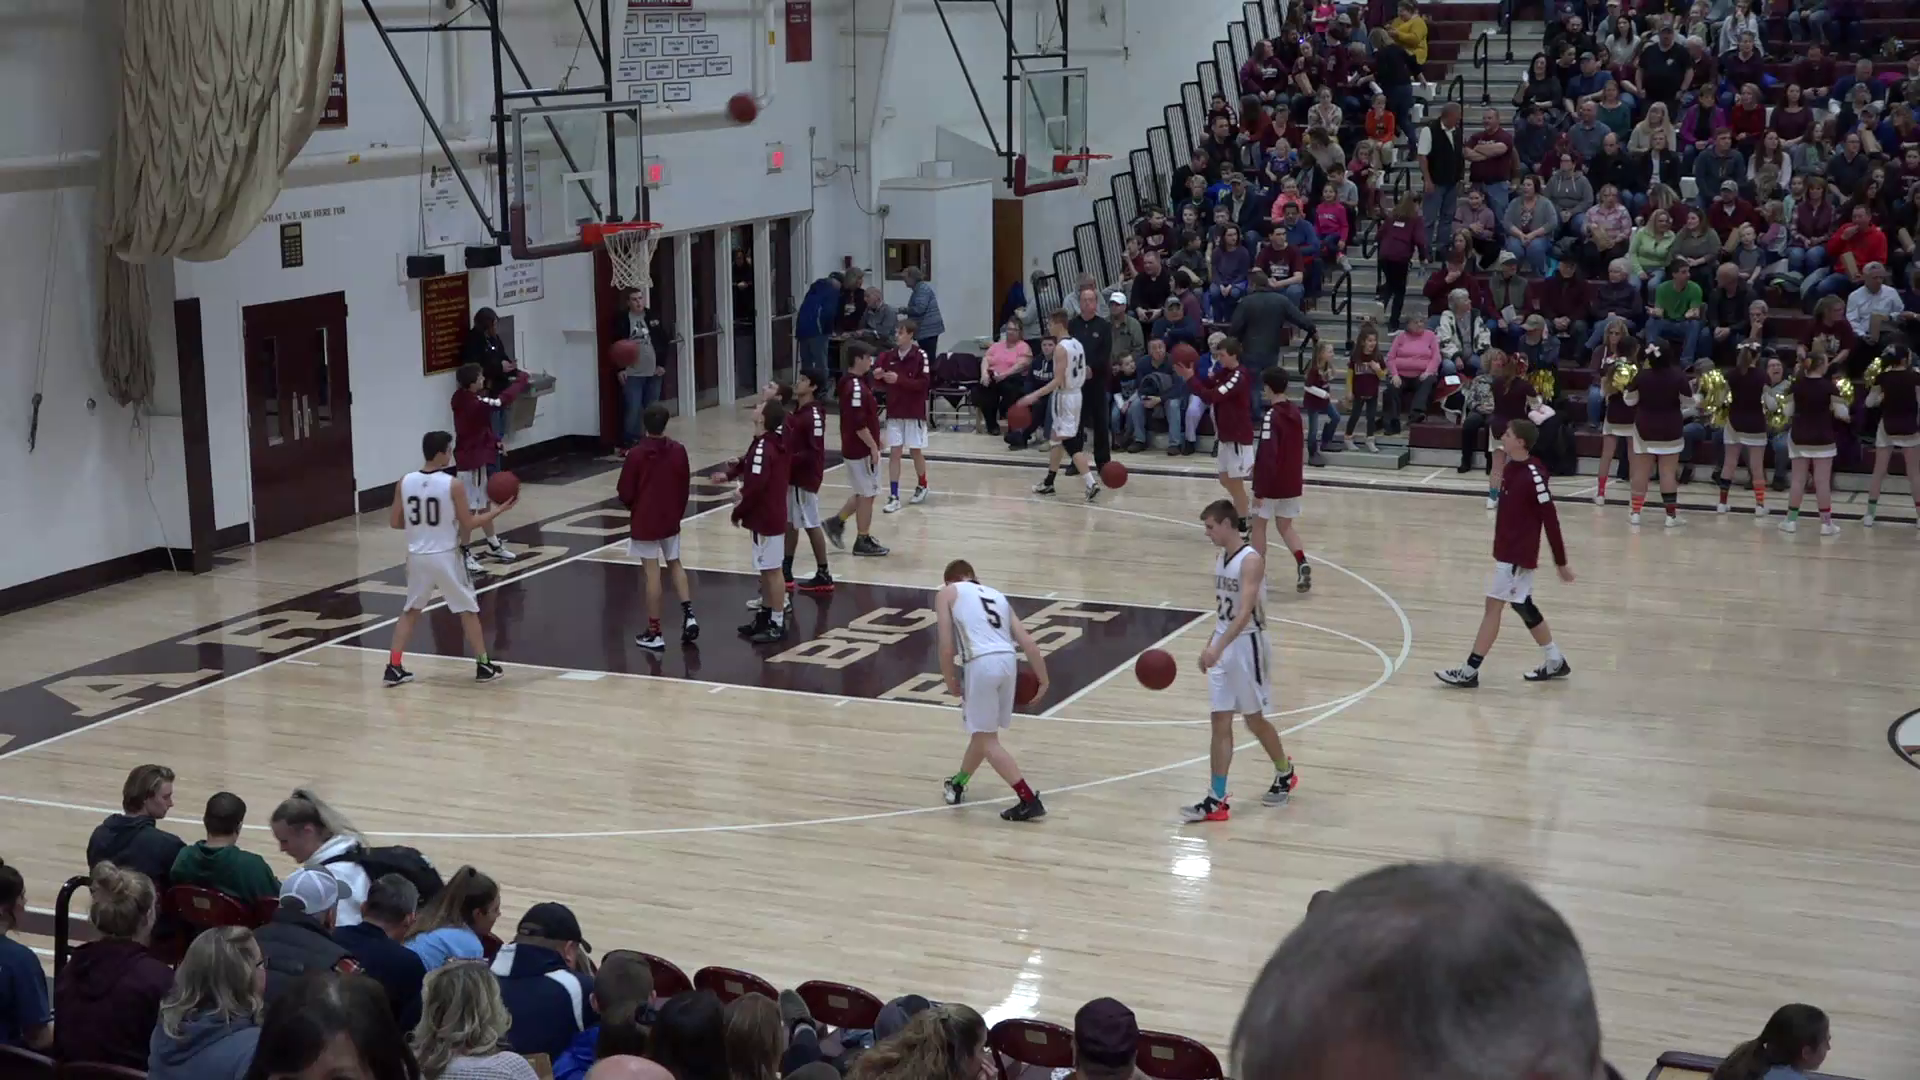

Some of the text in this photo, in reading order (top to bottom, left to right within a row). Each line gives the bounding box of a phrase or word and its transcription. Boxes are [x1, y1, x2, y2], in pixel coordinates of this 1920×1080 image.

[286, 211, 298, 220] WE
[300, 209, 313, 219] ARE
[314, 207, 332, 217] HERE
[334, 205, 346, 216] FOR
[407, 495, 441, 527] 30
[980, 596, 1002, 629] 5
[1215, 594, 1237, 621] 22
[765, 607, 938, 670] BIG
[876, 601, 1121, 707] EST
